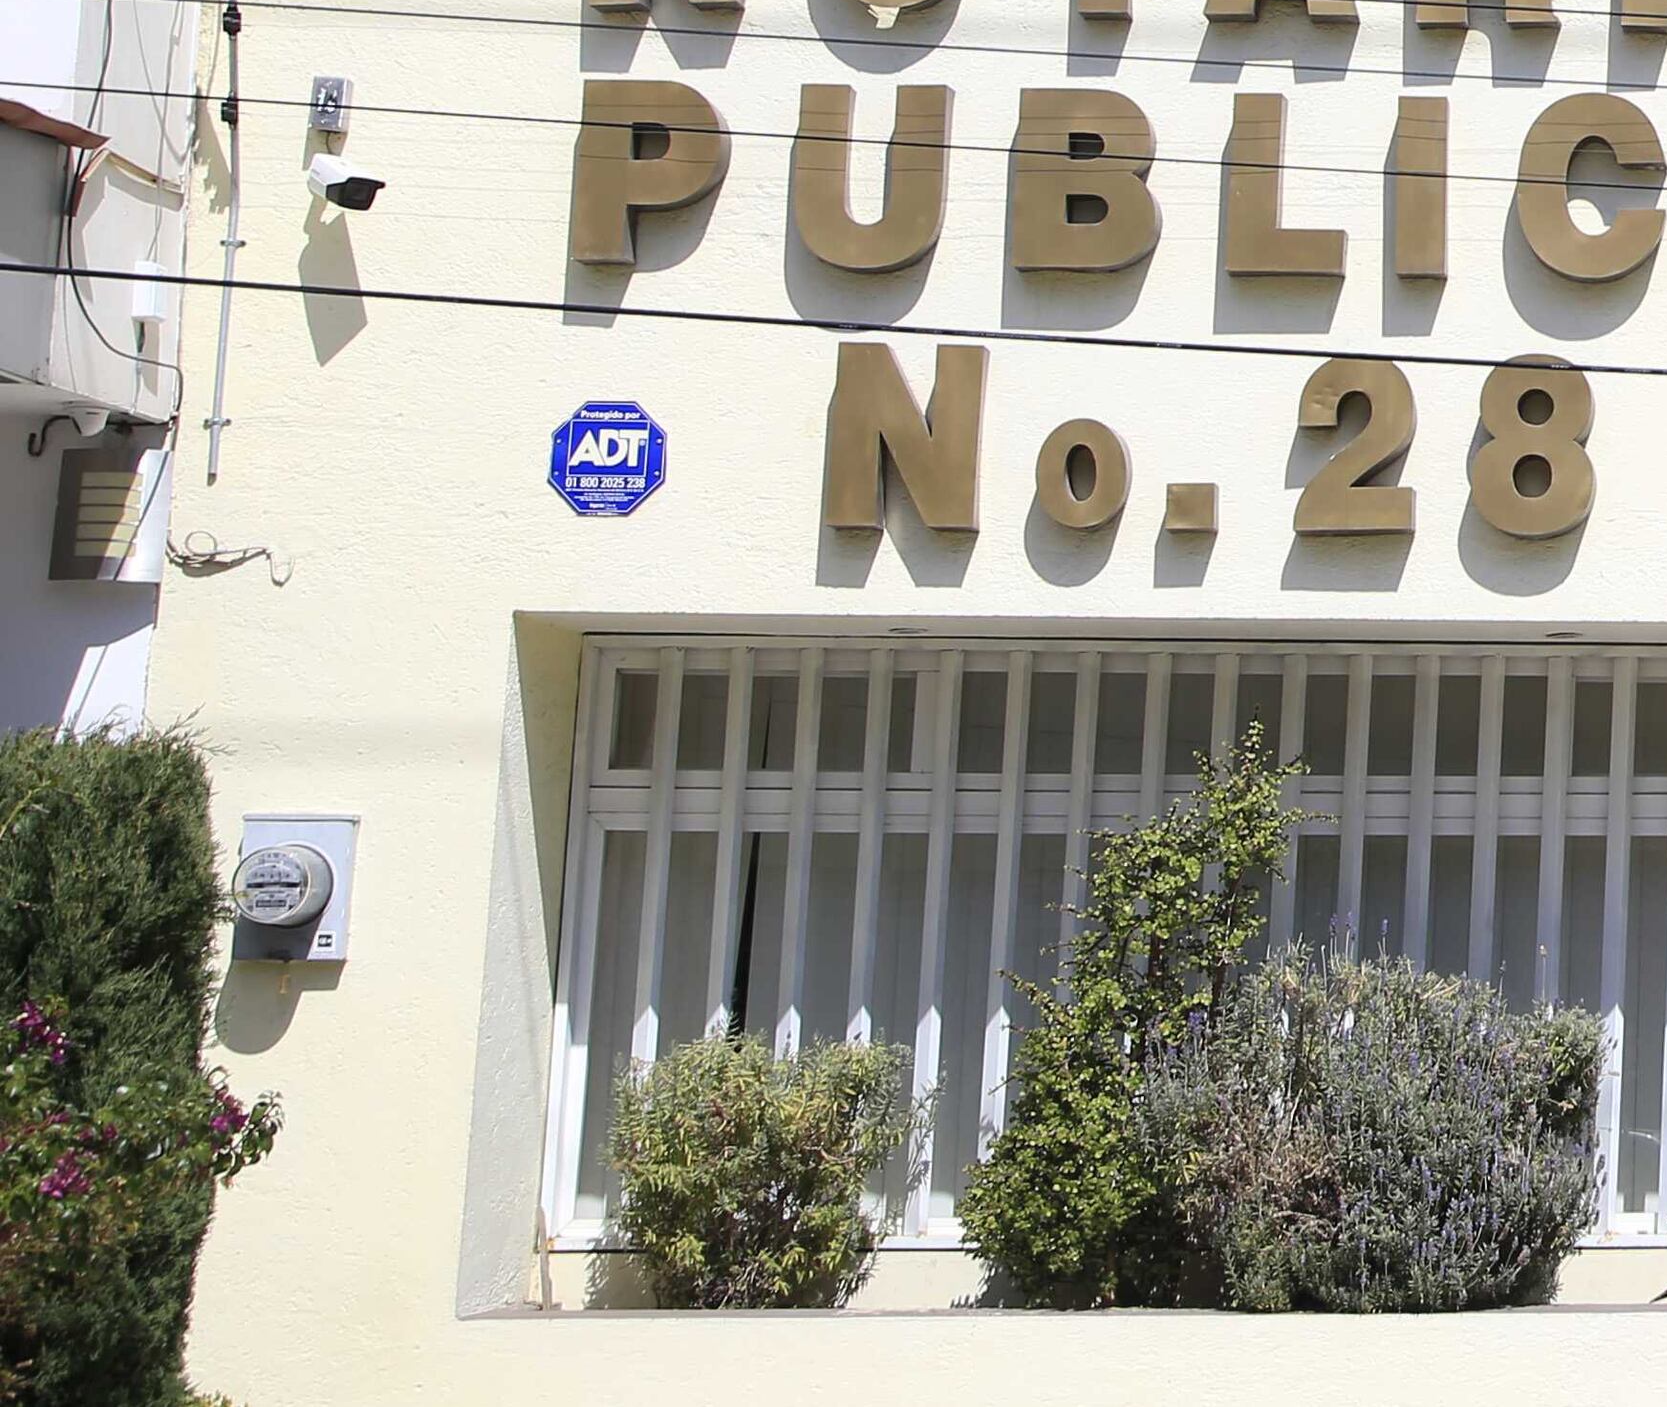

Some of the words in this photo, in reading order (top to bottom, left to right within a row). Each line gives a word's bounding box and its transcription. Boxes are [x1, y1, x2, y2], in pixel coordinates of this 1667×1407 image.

[581, 409, 624, 420] Protegido
[625, 411, 640, 420] por
[568, 428, 648, 467] ADT
[826, 341, 1218, 534] No.
[1293, 354, 1596, 539] 28
[565, 477, 577, 488] 01
[580, 477, 599, 488] 800
[600, 477, 625, 488] 2025
[627, 477, 646, 488] 238
